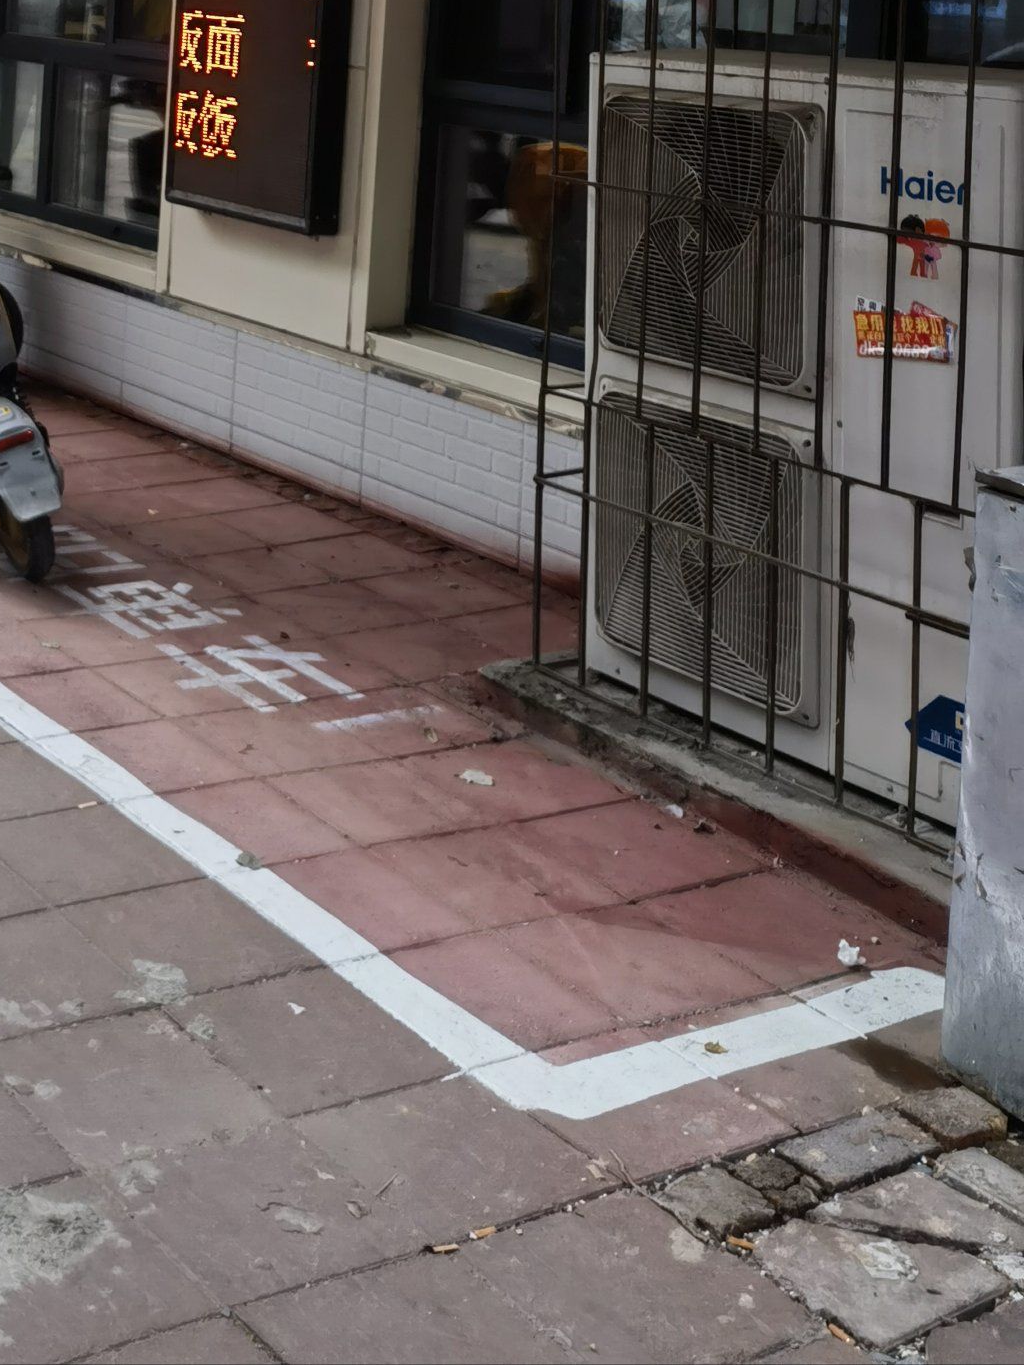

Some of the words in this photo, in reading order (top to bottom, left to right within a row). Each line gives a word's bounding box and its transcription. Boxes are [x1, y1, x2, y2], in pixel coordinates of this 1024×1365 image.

[880, 166, 965, 205] Haier
[856, 313, 944, 335] 急用找我们
